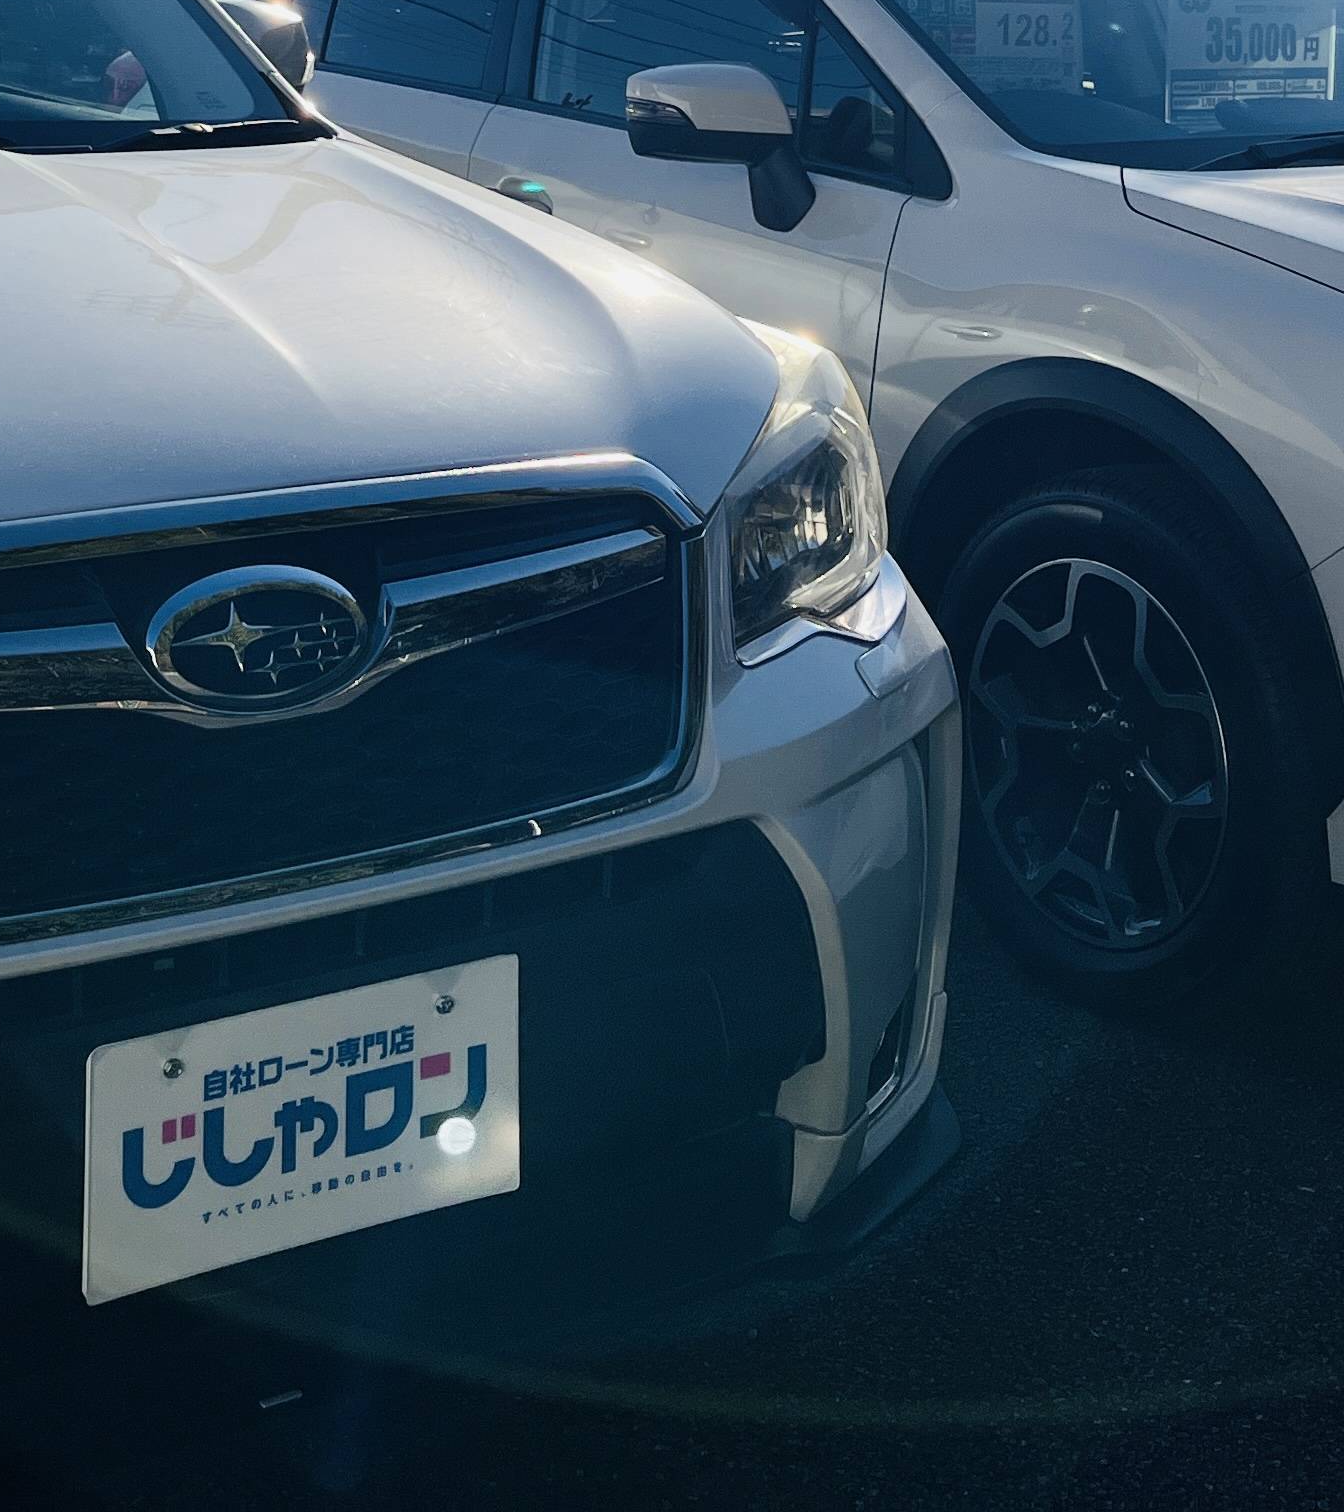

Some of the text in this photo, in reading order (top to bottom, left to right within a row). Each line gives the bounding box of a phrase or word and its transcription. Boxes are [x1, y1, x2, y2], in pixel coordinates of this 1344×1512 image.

[1206, 16, 1319, 65] 35,000 円
[203, 1025, 415, 1101] 自社ローン専門店
